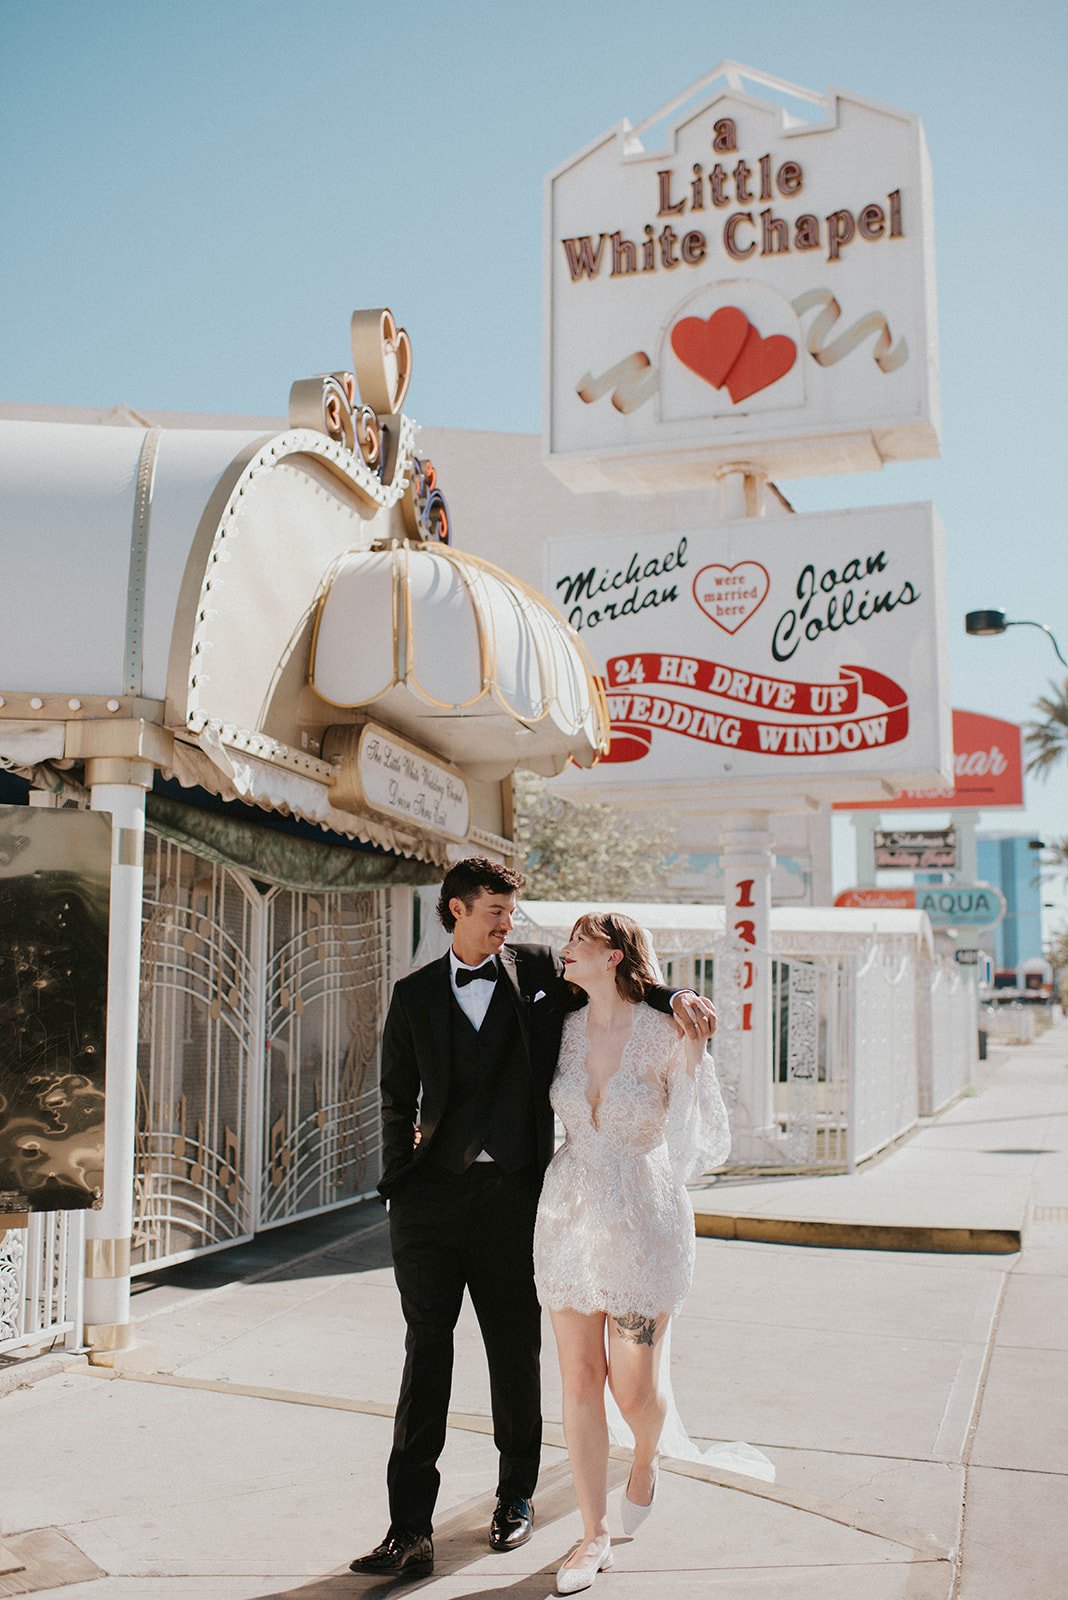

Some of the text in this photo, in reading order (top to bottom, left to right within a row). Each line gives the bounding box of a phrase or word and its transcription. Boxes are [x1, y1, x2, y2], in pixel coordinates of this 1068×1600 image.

[712, 117, 738, 153] a
[656, 153, 804, 218] Little
[562, 189, 905, 283] White Chapel
[556, 536, 688, 605] Michael
[703, 586, 758, 602] married
[714, 574, 745, 586] were
[795, 550, 891, 619] Joan
[566, 581, 679, 633] Jordan
[715, 603, 745, 617] here
[771, 580, 921, 662] Collins
[613, 656, 848, 713] 24 HR DRIVE UP
[606, 695, 889, 753] WEDDING WINDOW
[921, 893, 990, 915] AQUA
